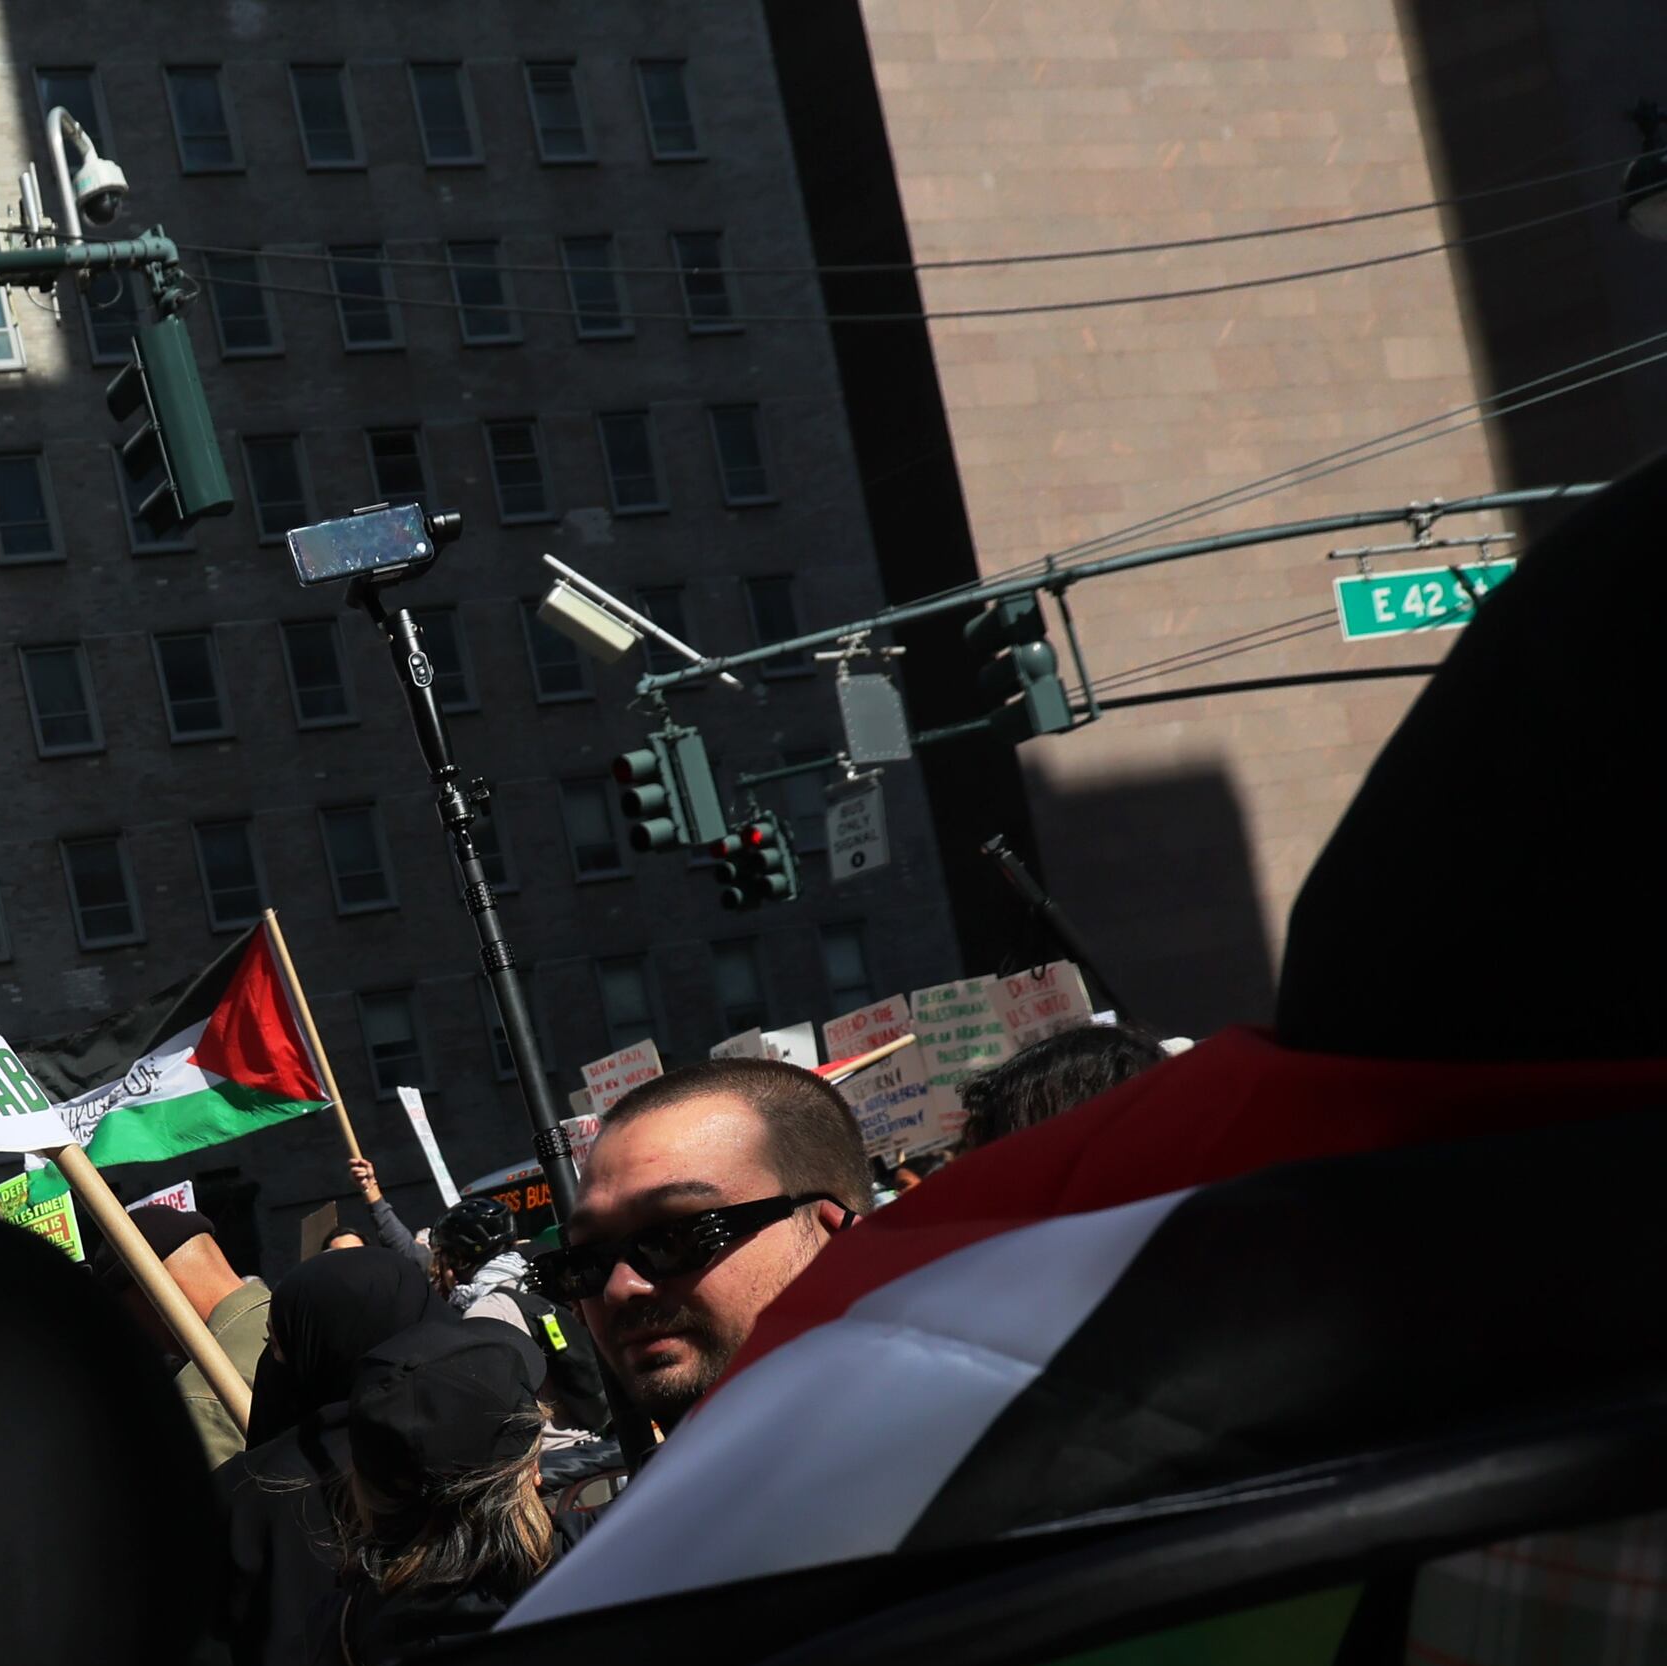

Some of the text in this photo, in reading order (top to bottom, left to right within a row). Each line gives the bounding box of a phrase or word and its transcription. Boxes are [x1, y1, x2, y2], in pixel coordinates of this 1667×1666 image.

[1371, 587, 1396, 624] E
[1402, 582, 1447, 620] 42
[7, 1196, 64, 1225] ALESTINE!
[51, 1216, 63, 1230] IS
